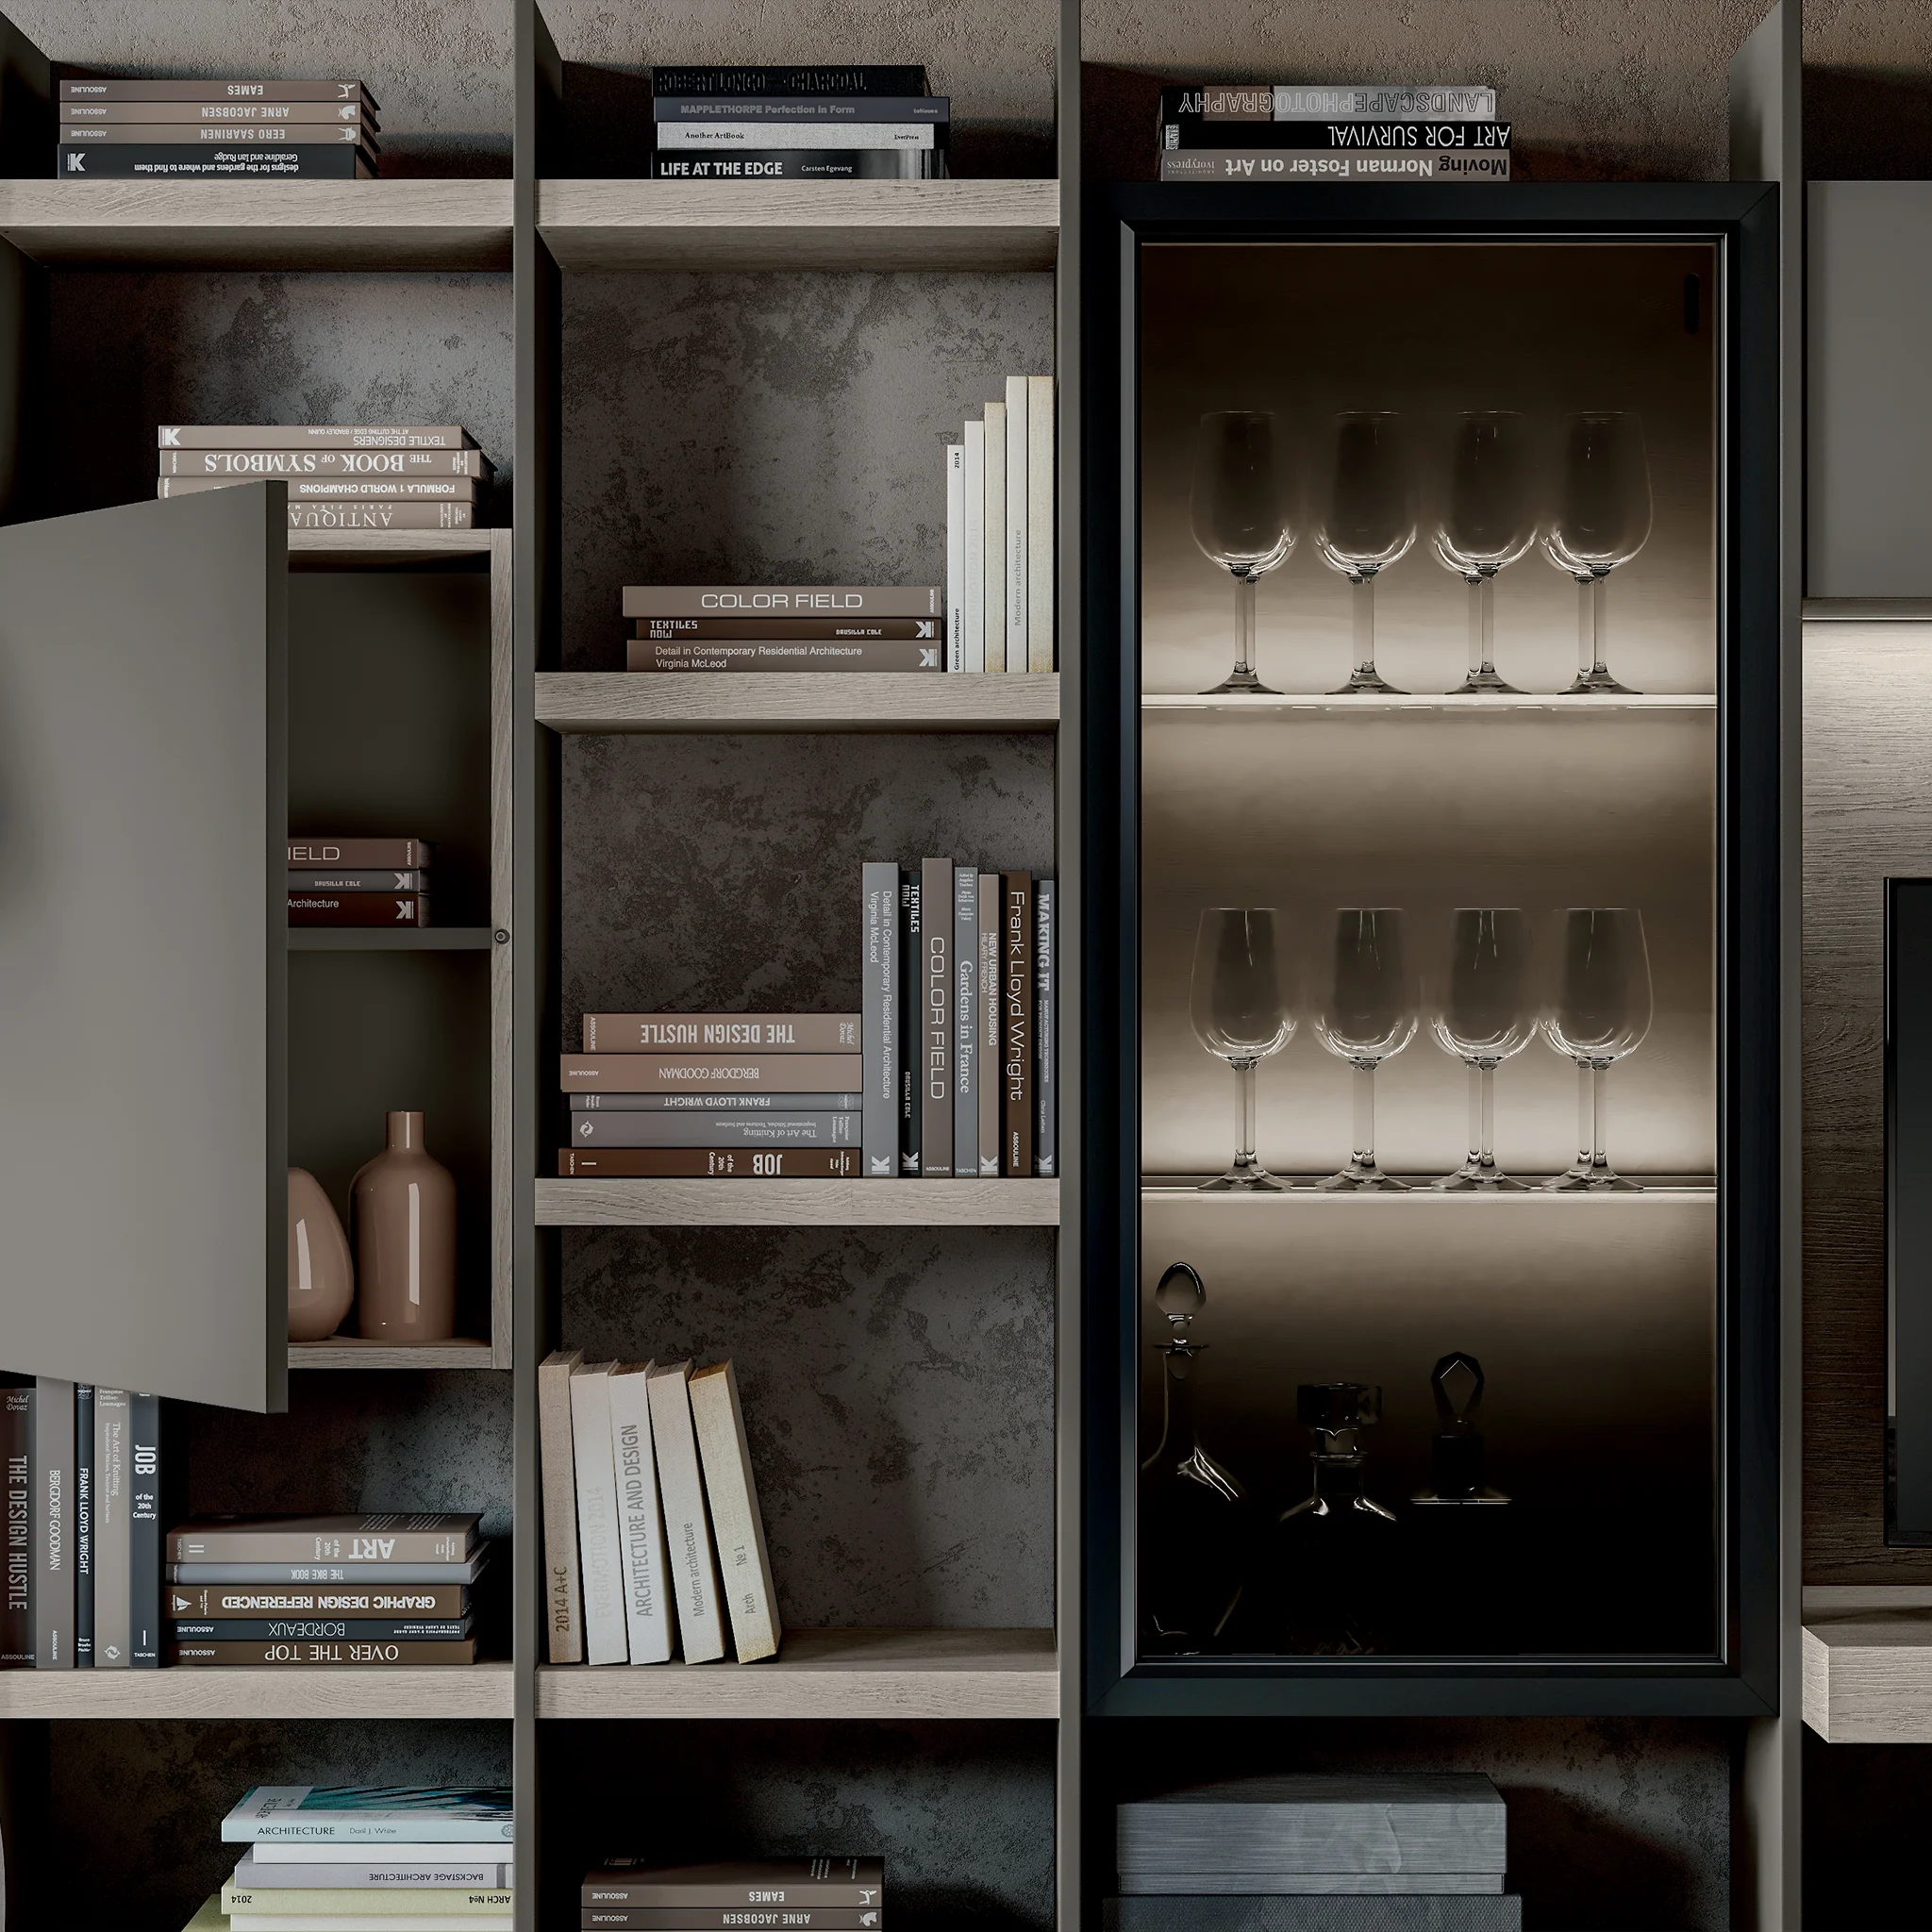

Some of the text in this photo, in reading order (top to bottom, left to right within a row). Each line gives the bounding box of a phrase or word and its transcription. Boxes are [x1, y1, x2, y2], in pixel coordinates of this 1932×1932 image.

[228, 85, 263, 95] EAMES
[202, 108, 289, 117] ARNE JACOBSEN
[201, 129, 285, 139] EERO SAARINEN
[1328, 125, 1510, 146] ART FOR SURVIVAL
[214, 153, 236, 162] Rudge
[250, 154, 263, 162] and
[265, 154, 297, 162] Geraldine
[154, 164, 168, 173] find
[217, 163, 245, 172] gardens
[246, 164, 258, 173] the
[259, 164, 270, 173] for
[272, 163, 298, 173] designs
[661, 162, 782, 175] LIFE AT THE EDGE
[1225, 155, 1507, 176] Moving Norman Foster on Art
[354, 436, 445, 445] TEXTILE DESIGNERS
[205, 455, 315, 472] SYMBOLS
[340, 455, 404, 472] BOOK
[702, 594, 862, 608] COLOR FIELD
[650, 621, 697, 629] TEXTILES
[656, 646, 862, 657] Detail in Contemporary Residential Architecture
[657, 659, 726, 669] Virginia McLeod
[287, 898, 339, 908] Architecture
[883, 891, 891, 916] Detail
[868, 891, 879, 962] Virginia McLeod
[1038, 892, 1050, 992] MAKING IT
[881, 929, 891, 991] Contemporary
[1007, 892, 1024, 1100] Frank Lloyd Wright
[883, 995, 891, 1043] Residential
[931, 938, 944, 1098] COLOR FIELD
[960, 960, 973, 1092] Gardens in France
[641, 1024, 795, 1043] THE DESIGN HUSTLE
[659, 1068, 759, 1078] BERGDORF GOODMAN
[883, 1046, 891, 1098] Architecture
[706, 1097, 736, 1106] LLOYD
[743, 1128, 775, 1138] Knitting
[753, 1154, 782, 1175] JOB
[6, 1394, 28, 1404] Michel
[135, 1445, 156, 1474] JOB
[110, 1464, 121, 1496] Knitting
[50, 1470, 60, 1570] BERGDORF GOODMAN
[80, 1502, 89, 1533] LLOYD
[621, 1424, 654, 1618] ARCHITECTURE AND DESIGN
[8, 1456, 27, 1609] THE DESIGN HUSTLE
[80, 1535, 89, 1574] WRIGHT
[348, 1539, 395, 1558] ART
[291, 1570, 343, 1579] THE BIKE BOOK
[683, 1522, 705, 1617] Modern architecture
[222, 1596, 435, 1608] GRAPHIC DESIGN REFERENCED
[554, 1566, 570, 1633] 2014 A+C
[744, 1592, 756, 1615] Arch
[269, 1623, 344, 1636] BORDEAUX
[265, 1645, 398, 1660] OVER THE TOP
[749, 1891, 784, 1901] EAMES
[724, 1914, 810, 1924] ARNE JACOBSEN
